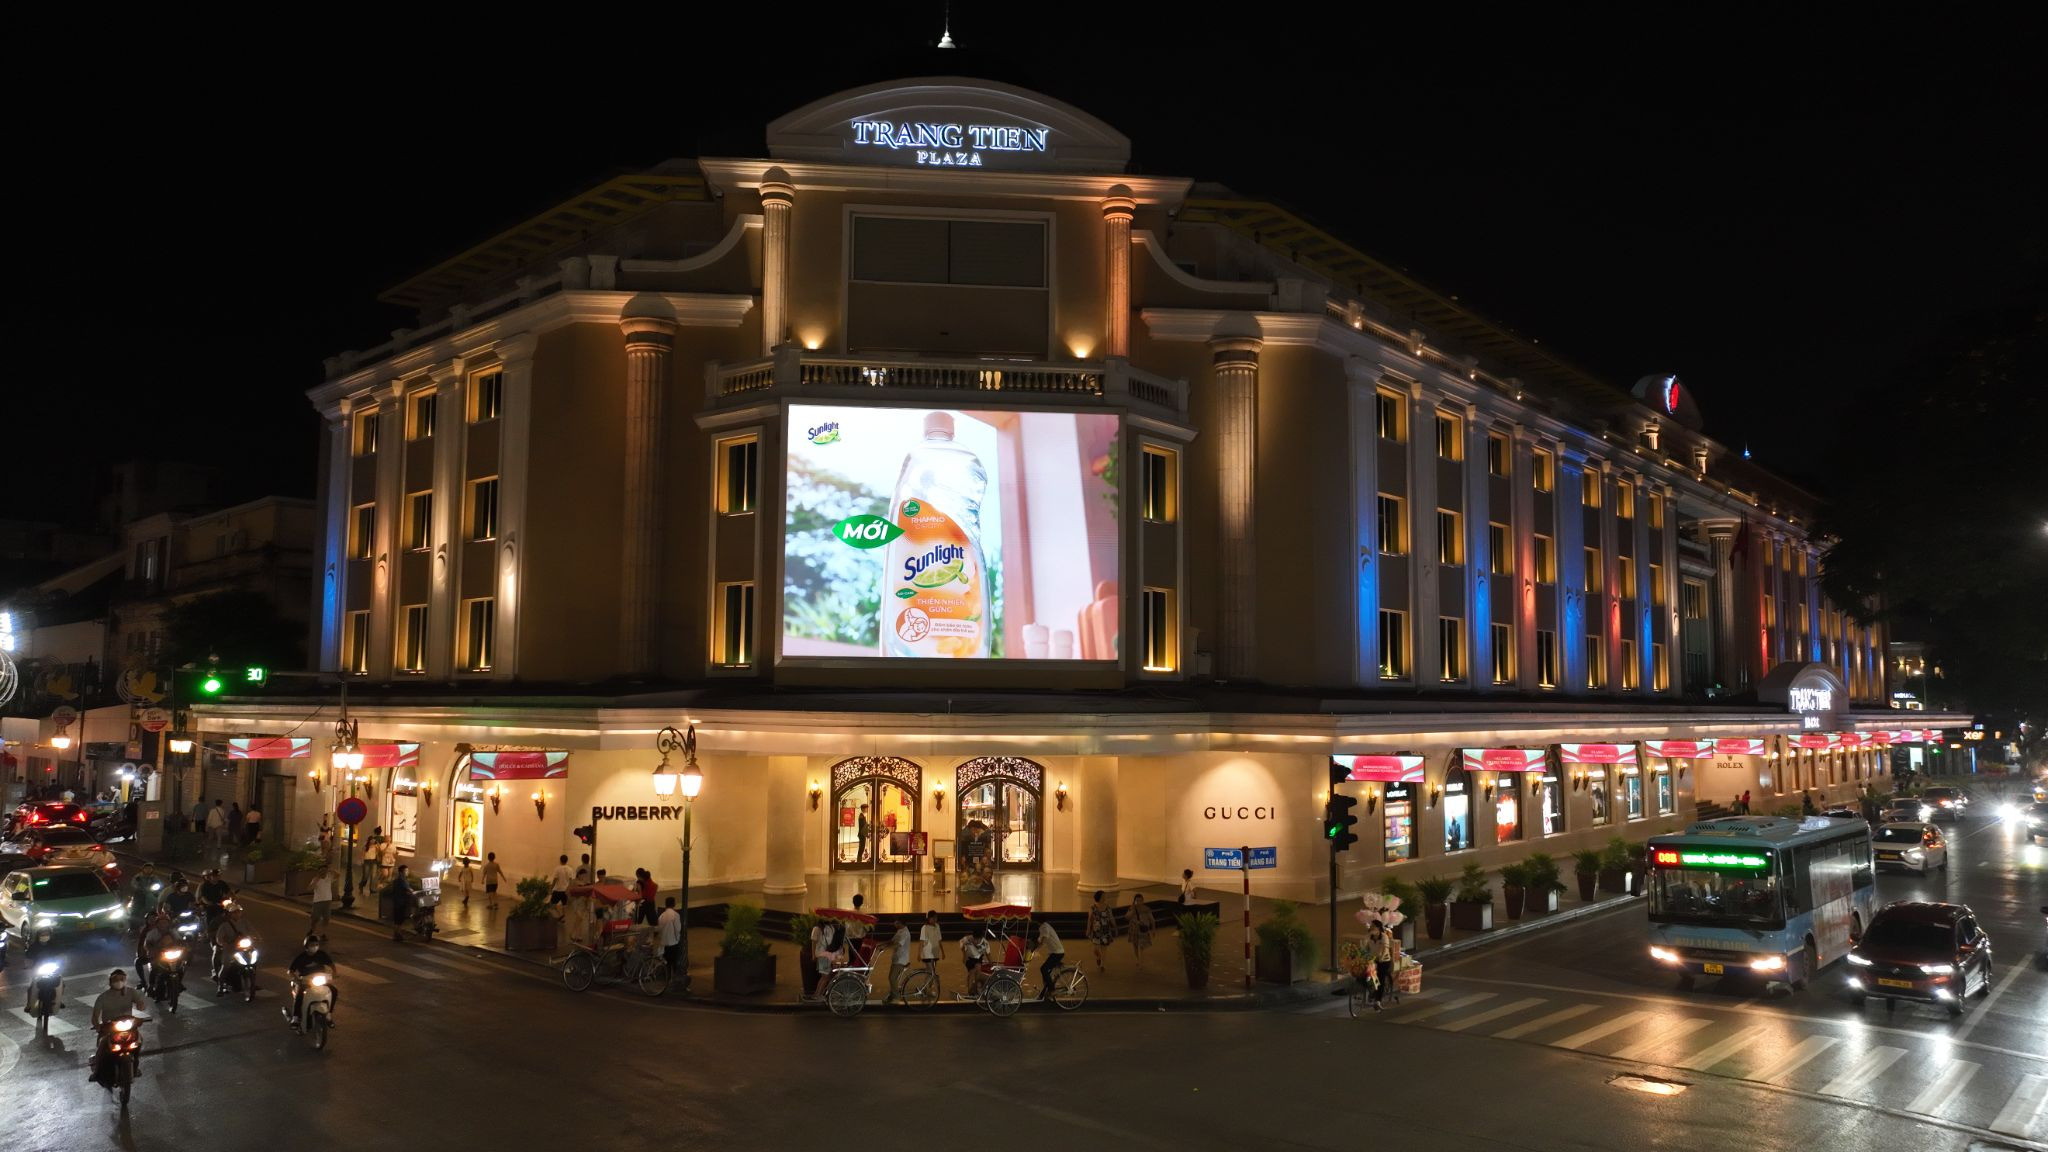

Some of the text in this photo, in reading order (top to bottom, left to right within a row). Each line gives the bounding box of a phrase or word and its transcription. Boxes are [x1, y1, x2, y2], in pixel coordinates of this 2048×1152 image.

[852, 121, 1048, 151] TRANG TIEN
[916, 151, 982, 165] PLAZA
[808, 421, 839, 440] Sunlight
[843, 520, 888, 540] MỚI
[904, 544, 964, 580] Sunlight
[248, 668, 262, 680] 30
[592, 806, 682, 820] BURBERRY
[1204, 807, 1275, 819] GUCCI
[1208, 856, 1227, 866] TRÀNG
